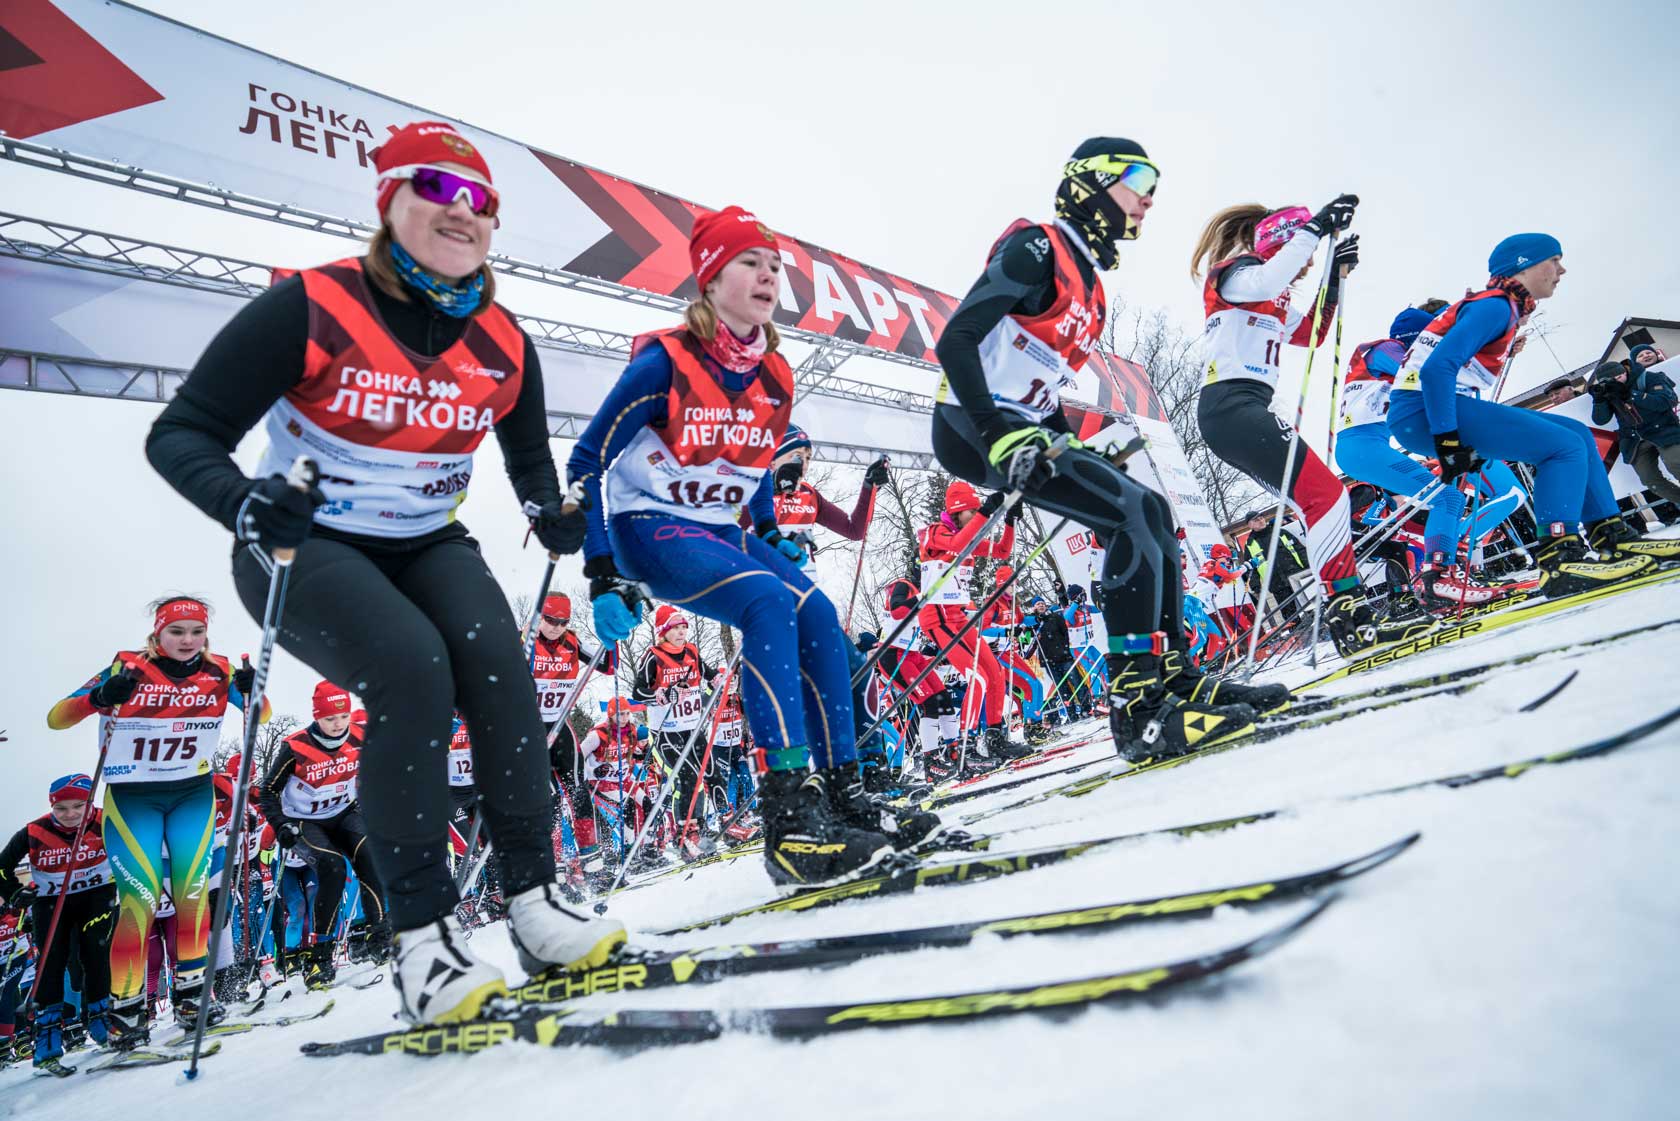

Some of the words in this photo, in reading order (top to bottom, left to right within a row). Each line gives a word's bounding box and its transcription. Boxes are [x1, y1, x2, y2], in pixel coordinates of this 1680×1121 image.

[248, 83, 374, 138] ГОНКА
[340, 366, 424, 396] ГОНКА
[326, 388, 494, 432] ЛЕГКОВА
[684, 407, 734, 422] ГОНКА
[680, 424, 776, 449] ЛЕГКОВА
[1348, 622, 1483, 676] FISCHER
[129, 693, 218, 707] ЛЕГКОВА
[138, 683, 180, 694] ГОНКА
[132, 736, 198, 762] 1175
[306, 759, 335, 772] ГОНКА
[39, 847, 73, 857] ГОНКА
[383, 1021, 515, 1055] FISCHER
